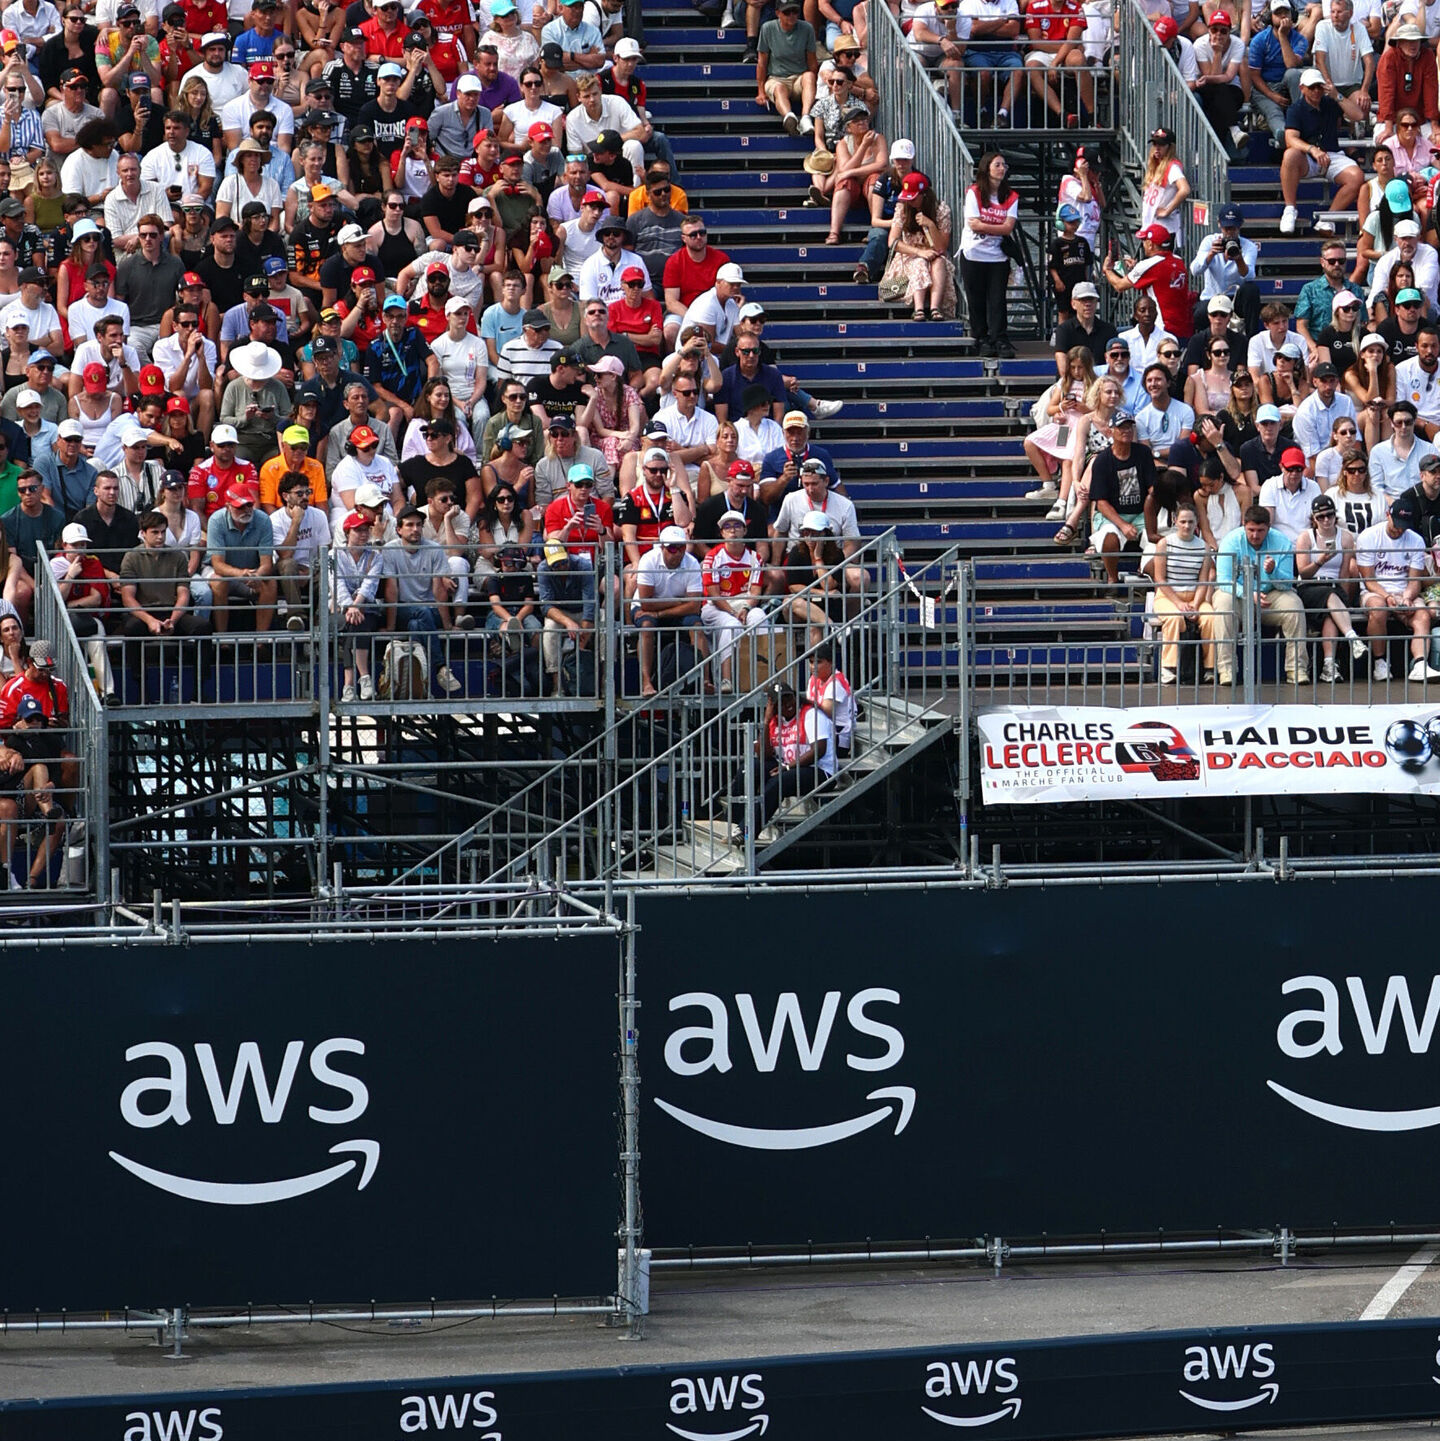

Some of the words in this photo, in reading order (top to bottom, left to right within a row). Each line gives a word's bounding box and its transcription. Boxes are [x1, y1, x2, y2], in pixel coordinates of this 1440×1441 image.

[252, 278, 268, 286] UFC
[1003, 723, 1114, 742] CHARLES
[1203, 726, 1280, 746] HAI
[1287, 726, 1374, 745] DUE
[986, 742, 1114, 769] LECLERC
[1206, 750, 1388, 770] D'ACCIAIO
[1016, 770, 1039, 778] THE
[1046, 767, 1105, 777] OFFICIAL
[1002, 778, 1053, 787] MARCHE
[1061, 776, 1084, 784] FAN
[1092, 774, 1123, 783] CLUB
[665, 988, 906, 1076] aws
[120, 1038, 369, 1129] aws
[926, 1358, 1019, 1398] aws
[1184, 1344, 1275, 1382] aws
[670, 1374, 765, 1412] aws
[400, 1392, 498, 1433] aws
